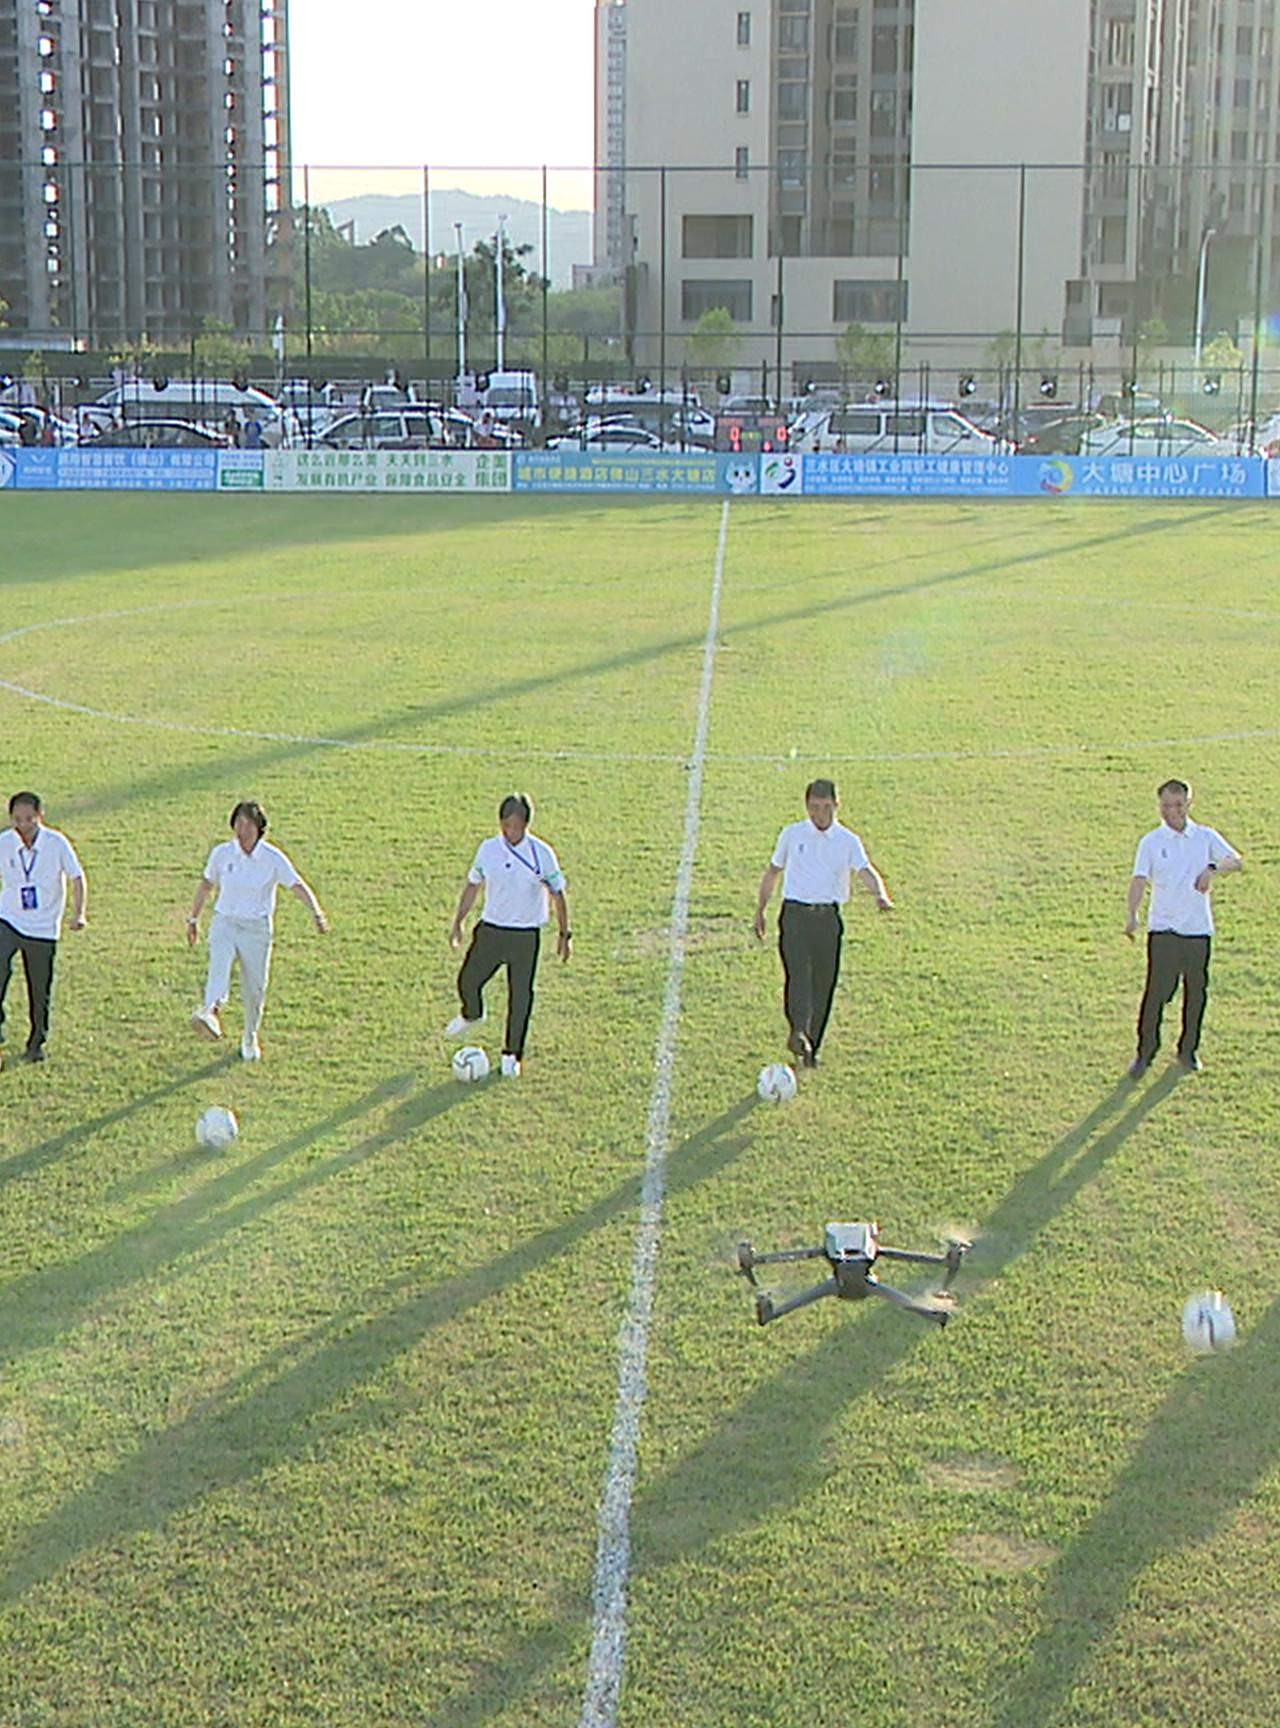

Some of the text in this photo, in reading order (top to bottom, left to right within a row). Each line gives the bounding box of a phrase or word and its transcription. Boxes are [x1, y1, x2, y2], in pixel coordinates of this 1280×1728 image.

[1081, 461, 1247, 484] 大塘中心广场
